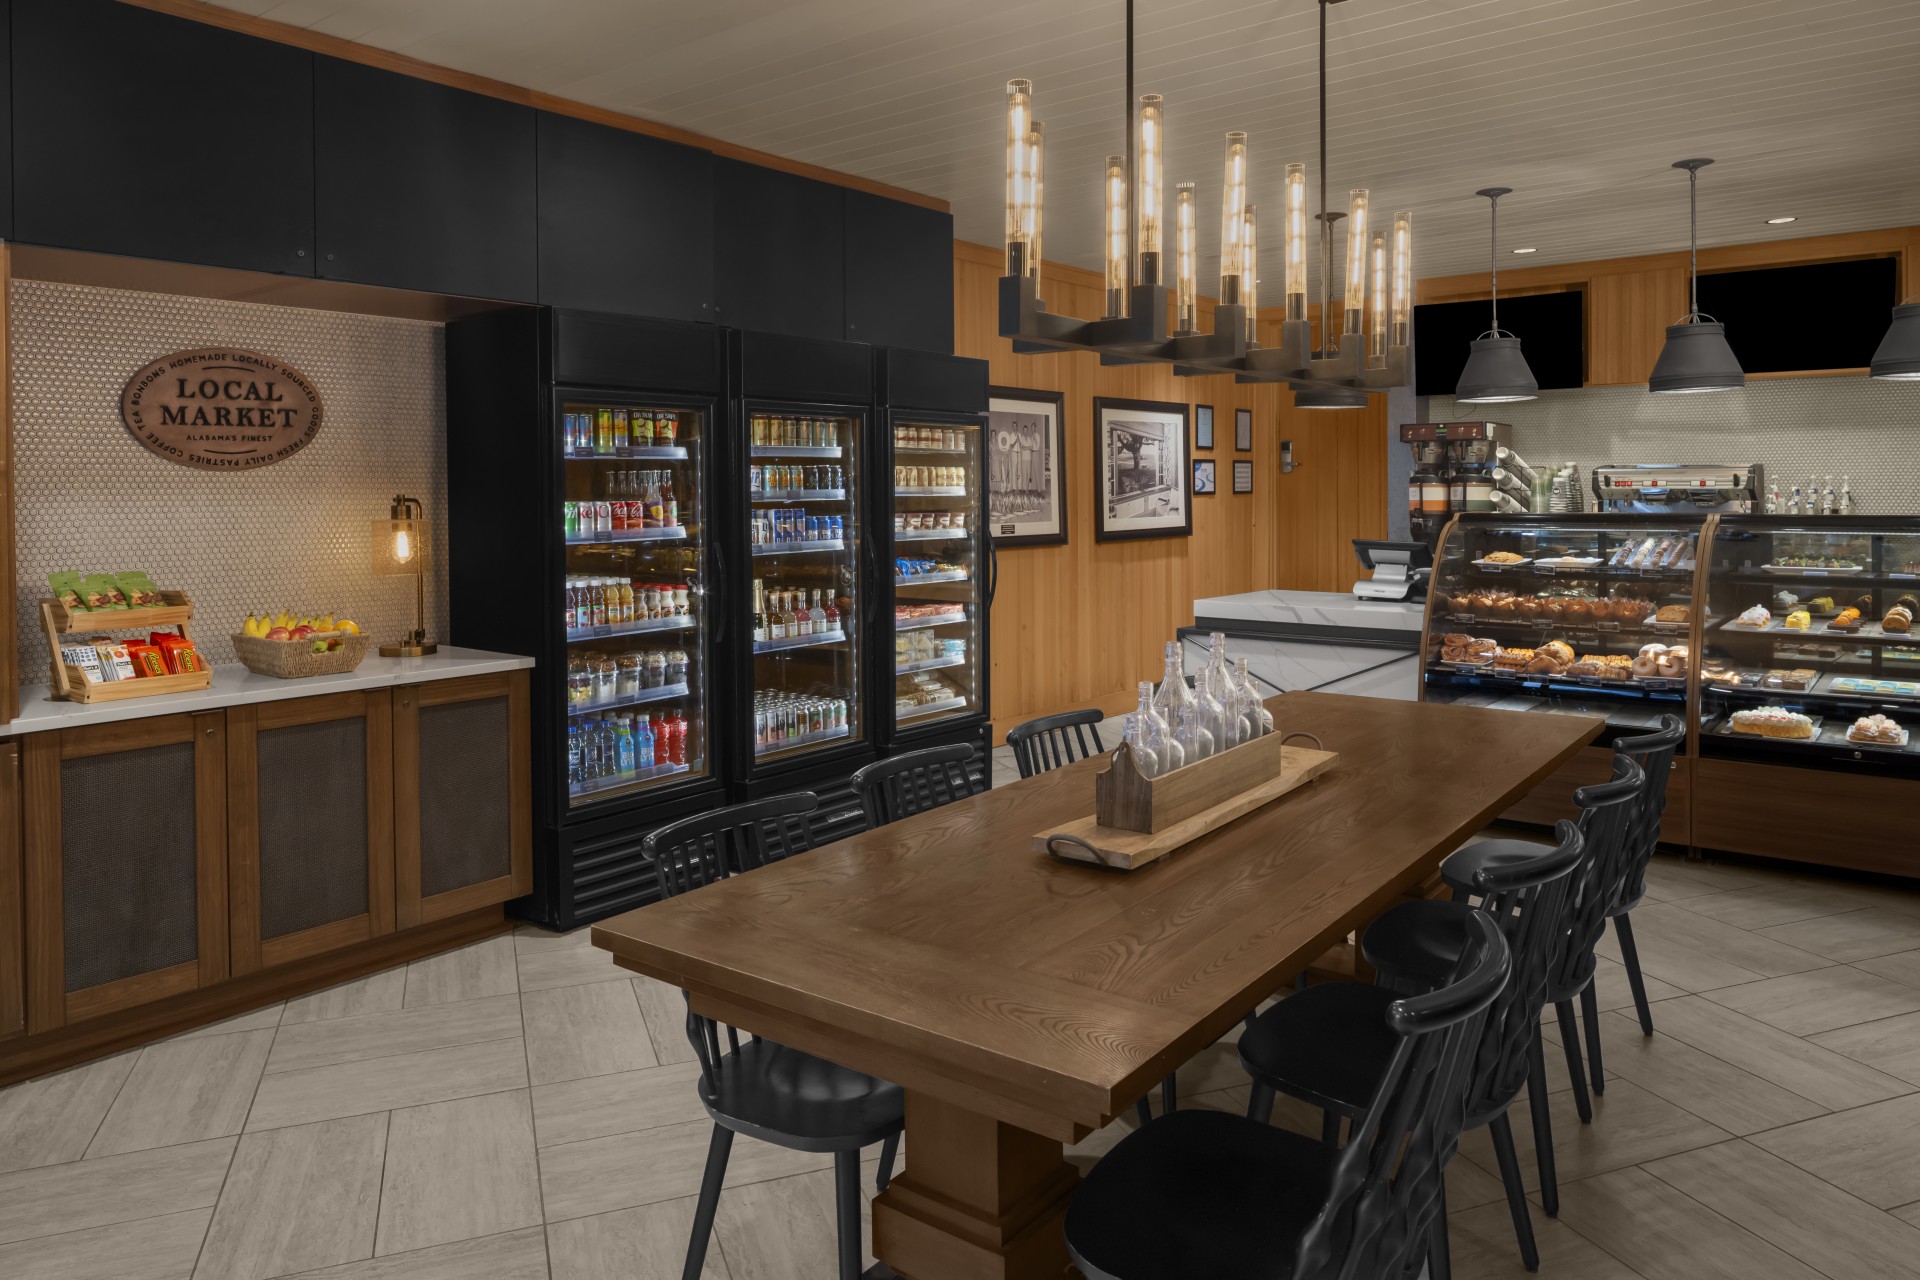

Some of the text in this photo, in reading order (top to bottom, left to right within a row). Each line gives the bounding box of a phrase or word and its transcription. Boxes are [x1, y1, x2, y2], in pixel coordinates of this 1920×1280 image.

[175, 378, 283, 402] LOCAL
[131, 353, 320, 467] TEA BONBONS HOMEMADE LOCALLY SOURCED GOODS FRESH DAILY PASTRIES COFFEE
[159, 404, 298, 428] MARKET
[186, 434, 273, 443] ALABAMA'S FINEST
